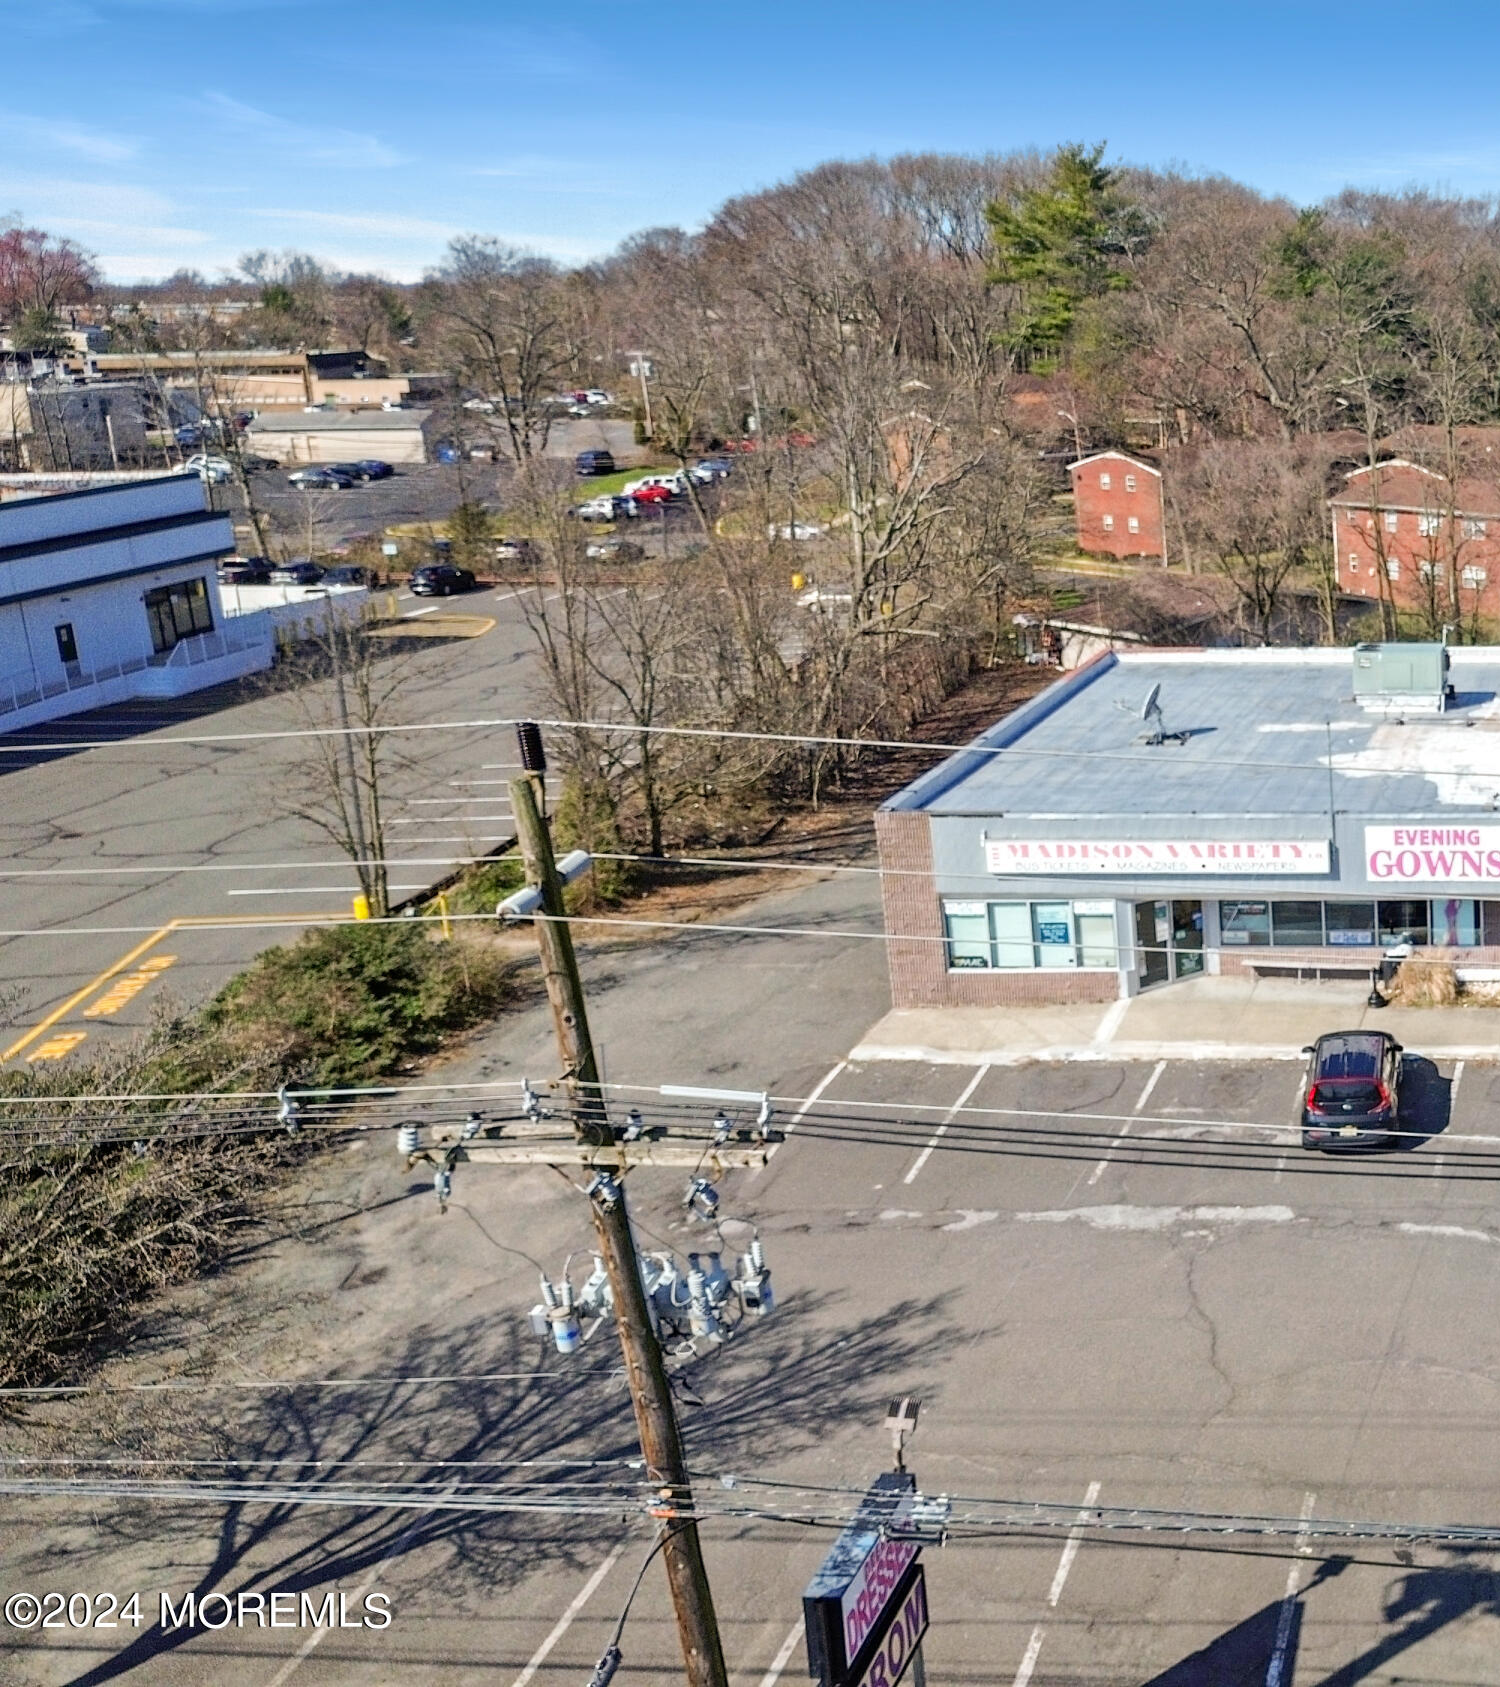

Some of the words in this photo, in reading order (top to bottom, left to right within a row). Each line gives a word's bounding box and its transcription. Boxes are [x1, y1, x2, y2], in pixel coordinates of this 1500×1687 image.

[1393, 830, 1480, 846] EVENING
[1007, 844, 1152, 859] MADISON
[1166, 844, 1307, 859] VARIETY
[1015, 862, 1040, 872] BUS
[1043, 862, 1090, 872] TICKETS
[1117, 862, 1188, 872] MAGAZINES
[1218, 862, 1297, 872] NEWSPAPERS
[861, 1581, 927, 1687] ROM
